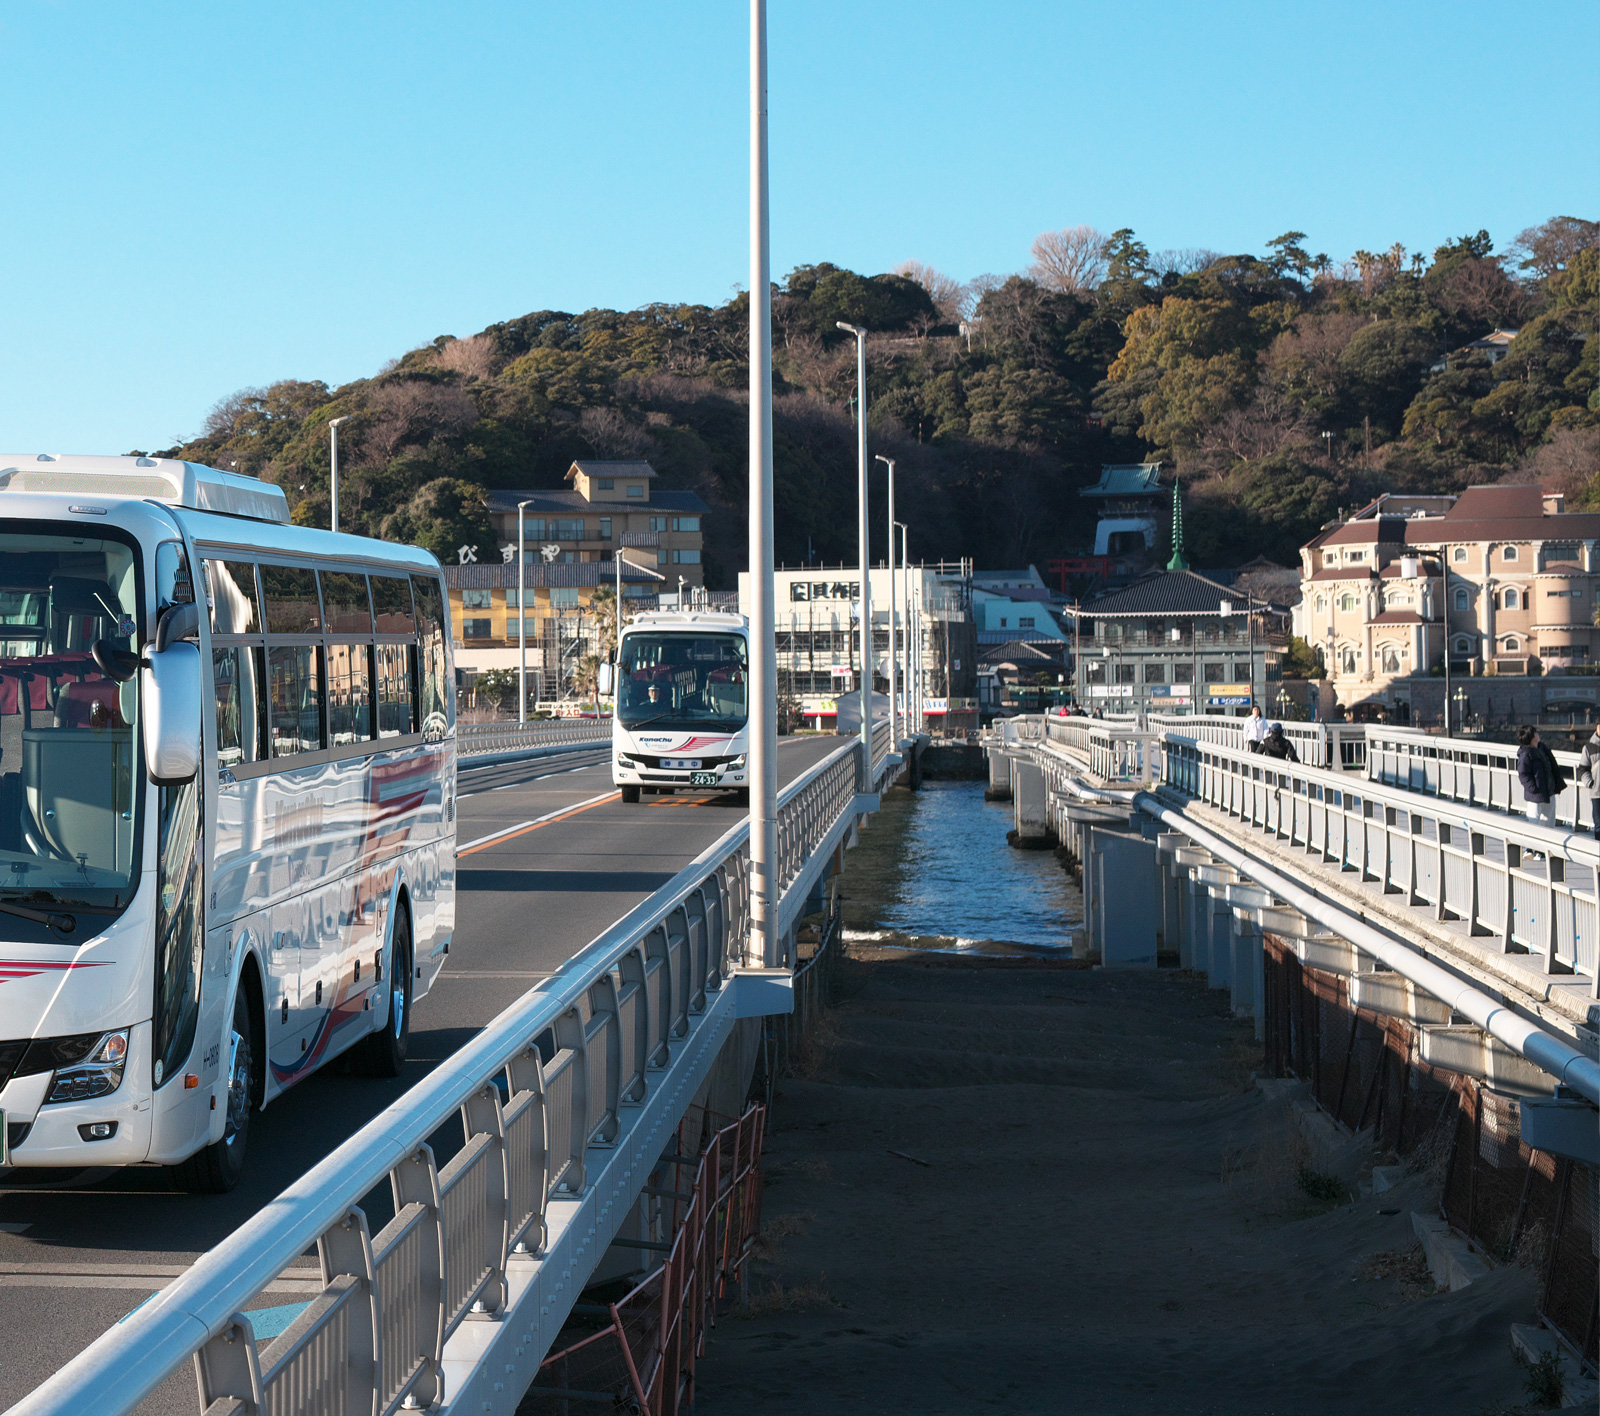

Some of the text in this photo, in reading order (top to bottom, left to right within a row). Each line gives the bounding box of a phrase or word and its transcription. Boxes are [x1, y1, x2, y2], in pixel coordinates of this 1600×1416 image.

[456, 543, 561, 565] びすや
[694, 776, 716, 785] 24-33
